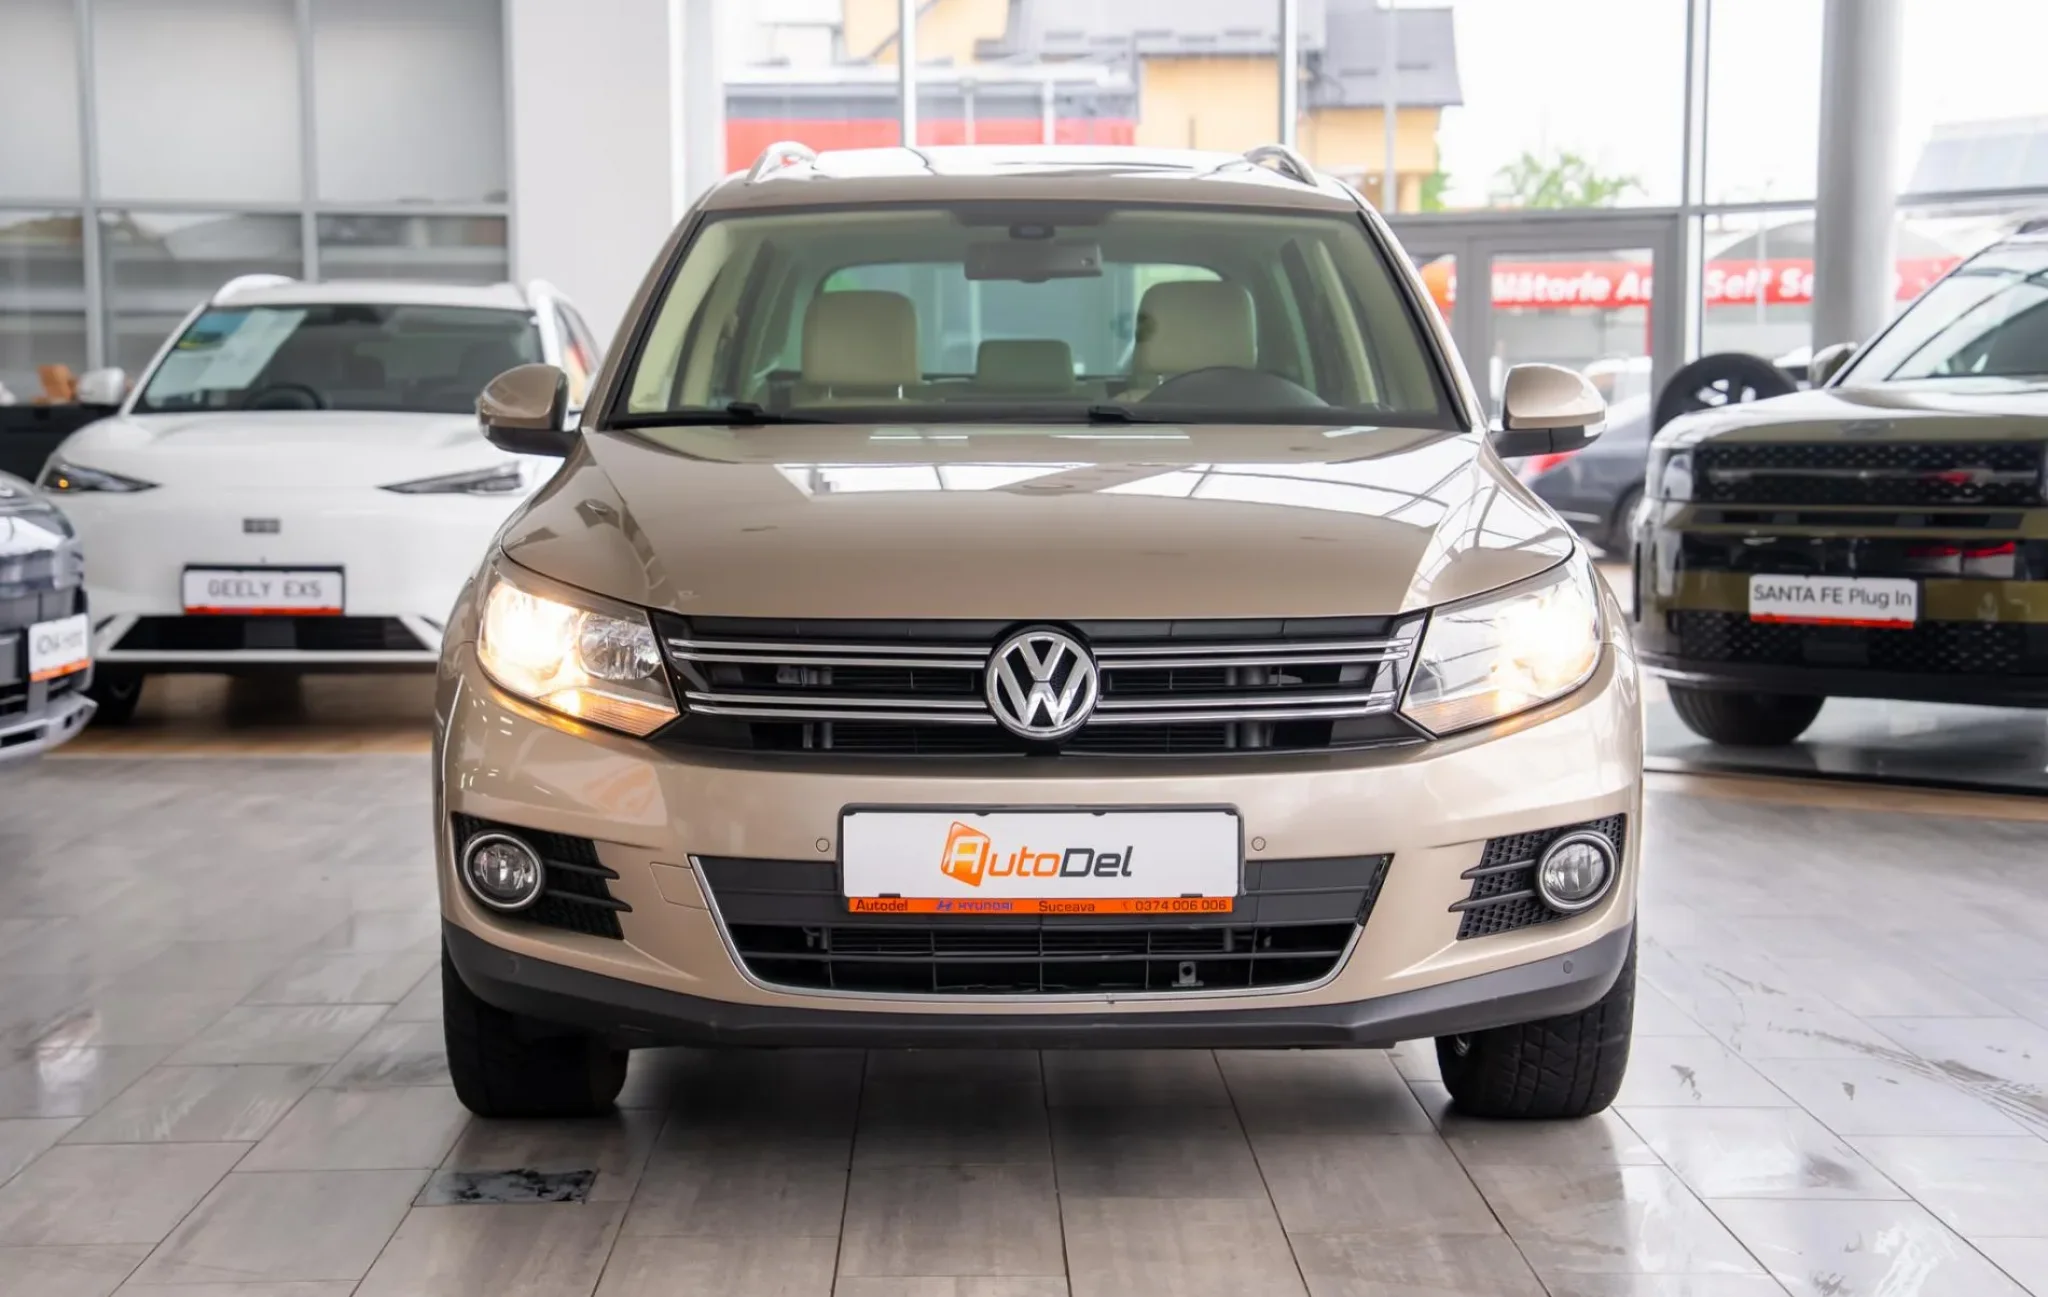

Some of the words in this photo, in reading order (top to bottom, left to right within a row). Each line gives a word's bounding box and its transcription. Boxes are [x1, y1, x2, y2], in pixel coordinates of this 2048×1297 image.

[207, 579, 272, 599] GEELY
[1754, 584, 1816, 603] SANTA
[1820, 586, 1844, 605] FE
[1849, 588, 1890, 610] Plug
[1895, 589, 1912, 607] In
[941, 824, 1134, 885] AutoDel
[855, 899, 909, 912] Autodel
[957, 900, 1013, 911] HYUNDAI
[1038, 900, 1096, 912] Suceava
[1135, 900, 1169, 911] 0374
[1172, 900, 1198, 911] 006
[1201, 900, 1227, 911] 006
